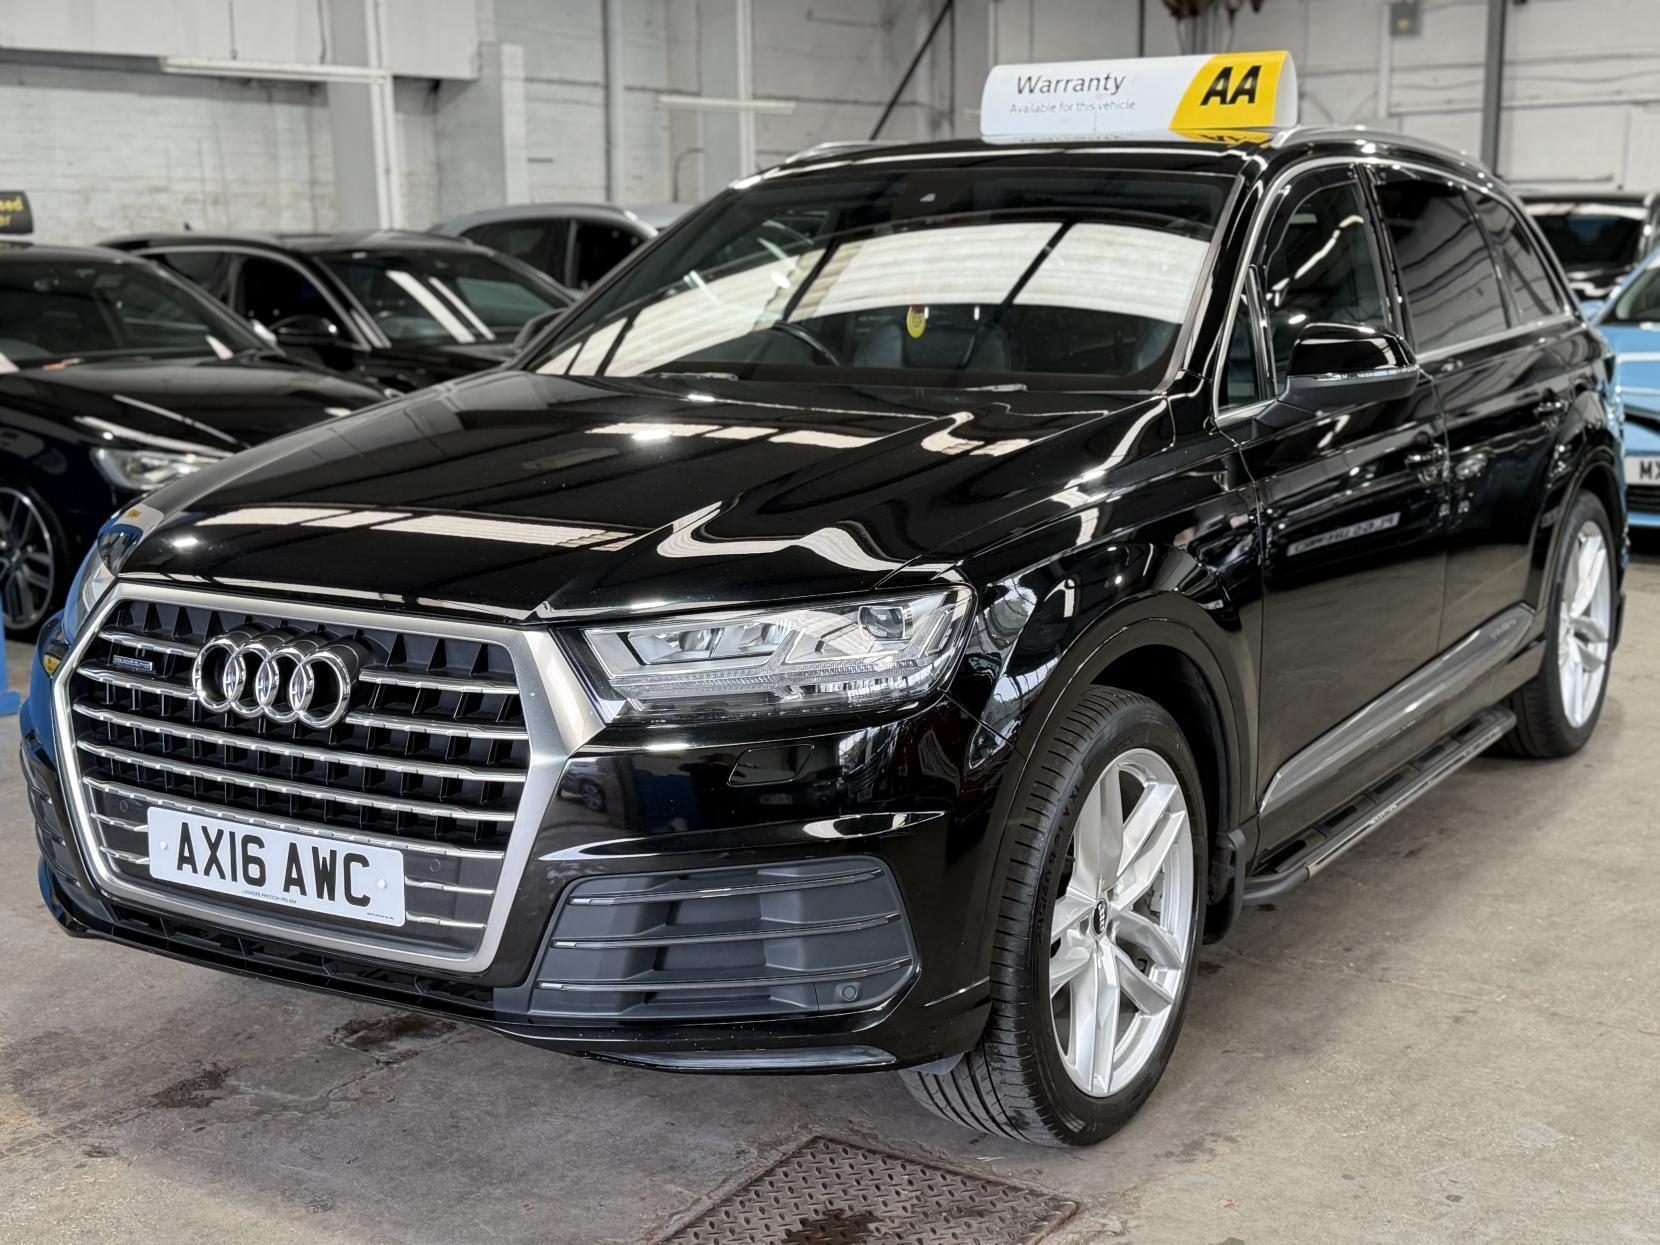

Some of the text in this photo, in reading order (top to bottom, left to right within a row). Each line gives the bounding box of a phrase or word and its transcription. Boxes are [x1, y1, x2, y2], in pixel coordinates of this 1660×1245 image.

[1017, 73, 1126, 96] Warranty
[1200, 65, 1262, 106] AA
[1009, 99, 1136, 114] Available for this vehicle
[114, 657, 150, 669] quattro
[176, 821, 371, 908] AX16 AWC
